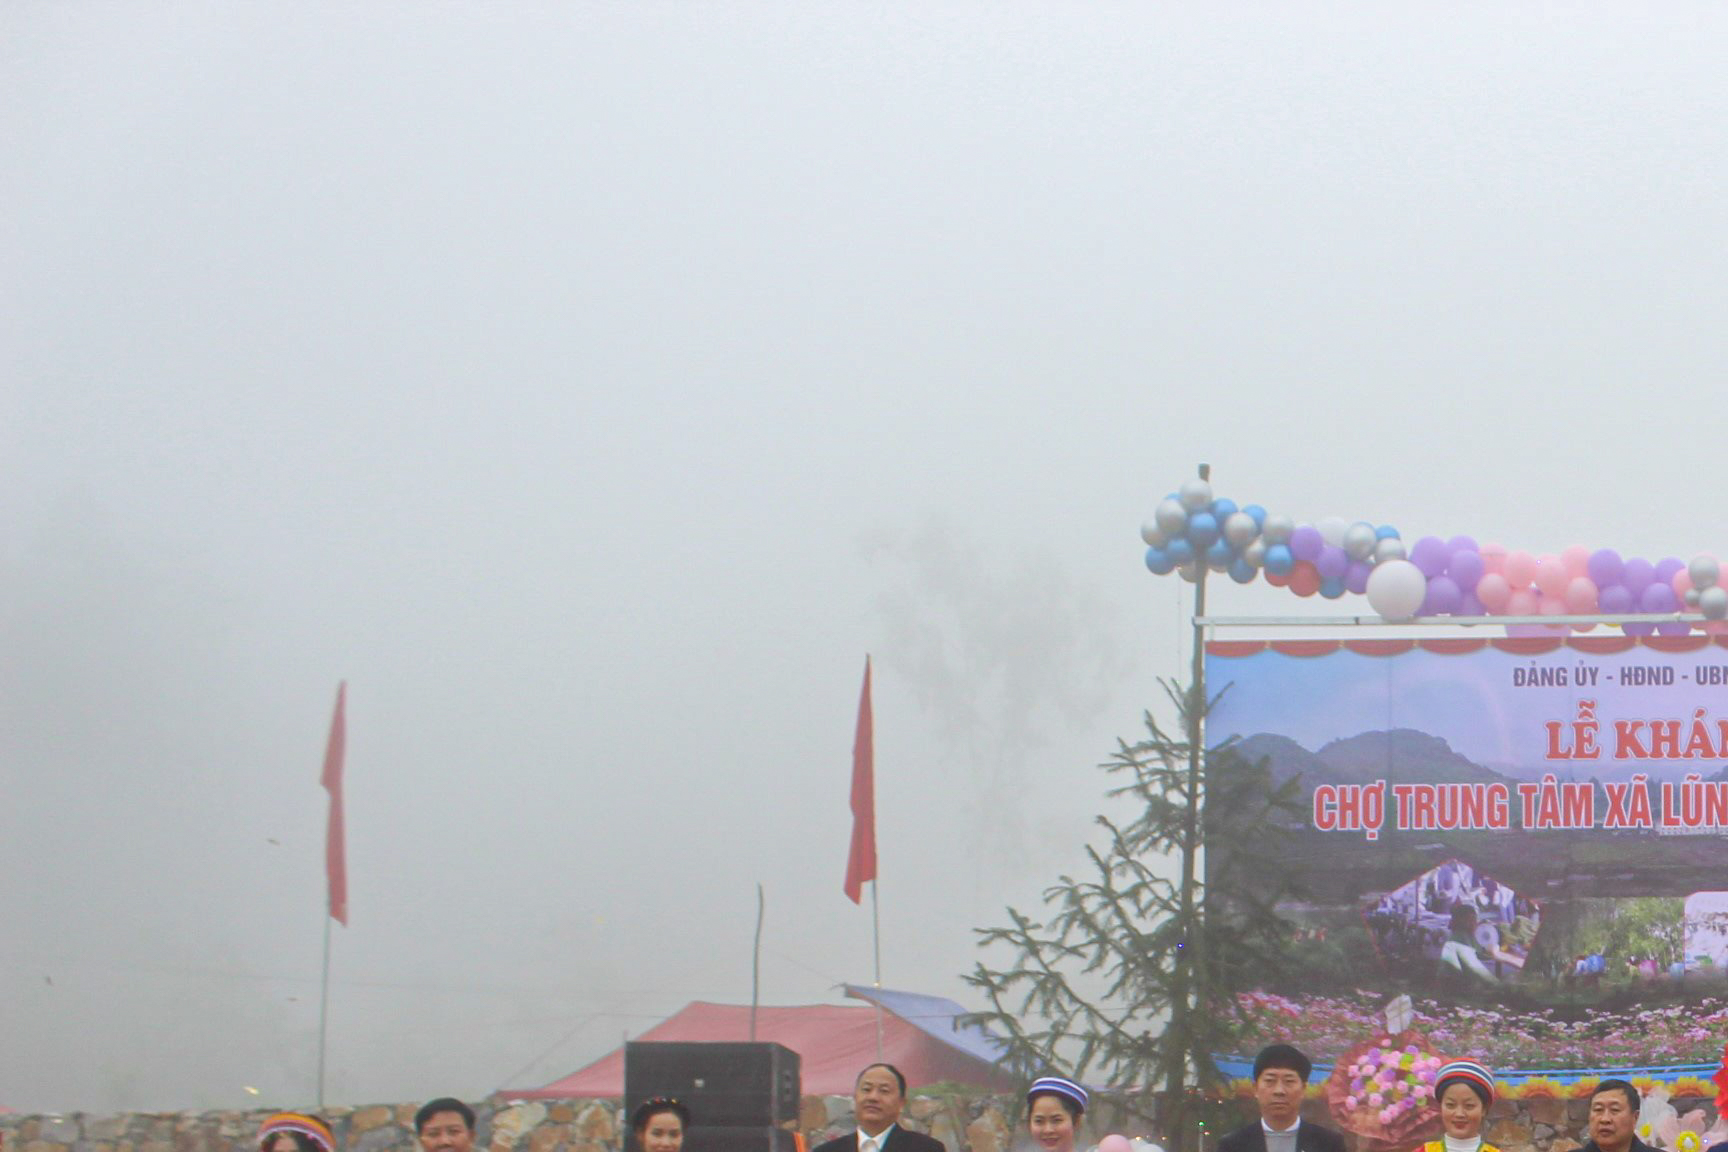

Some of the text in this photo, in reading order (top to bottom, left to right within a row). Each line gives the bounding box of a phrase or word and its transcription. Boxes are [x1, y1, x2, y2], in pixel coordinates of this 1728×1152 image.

[1513, 661, 1568, 687] ĐẢNG
[1574, 660, 1599, 686] ỦY
[1619, 666, 1674, 686] HĐND
[1545, 700, 1602, 760] LỄ
[1313, 779, 1386, 840] CHỢ
[1394, 783, 1510, 830] TRUNG
[1517, 774, 1595, 829] TÂM
[1603, 774, 1653, 829] XÃ
